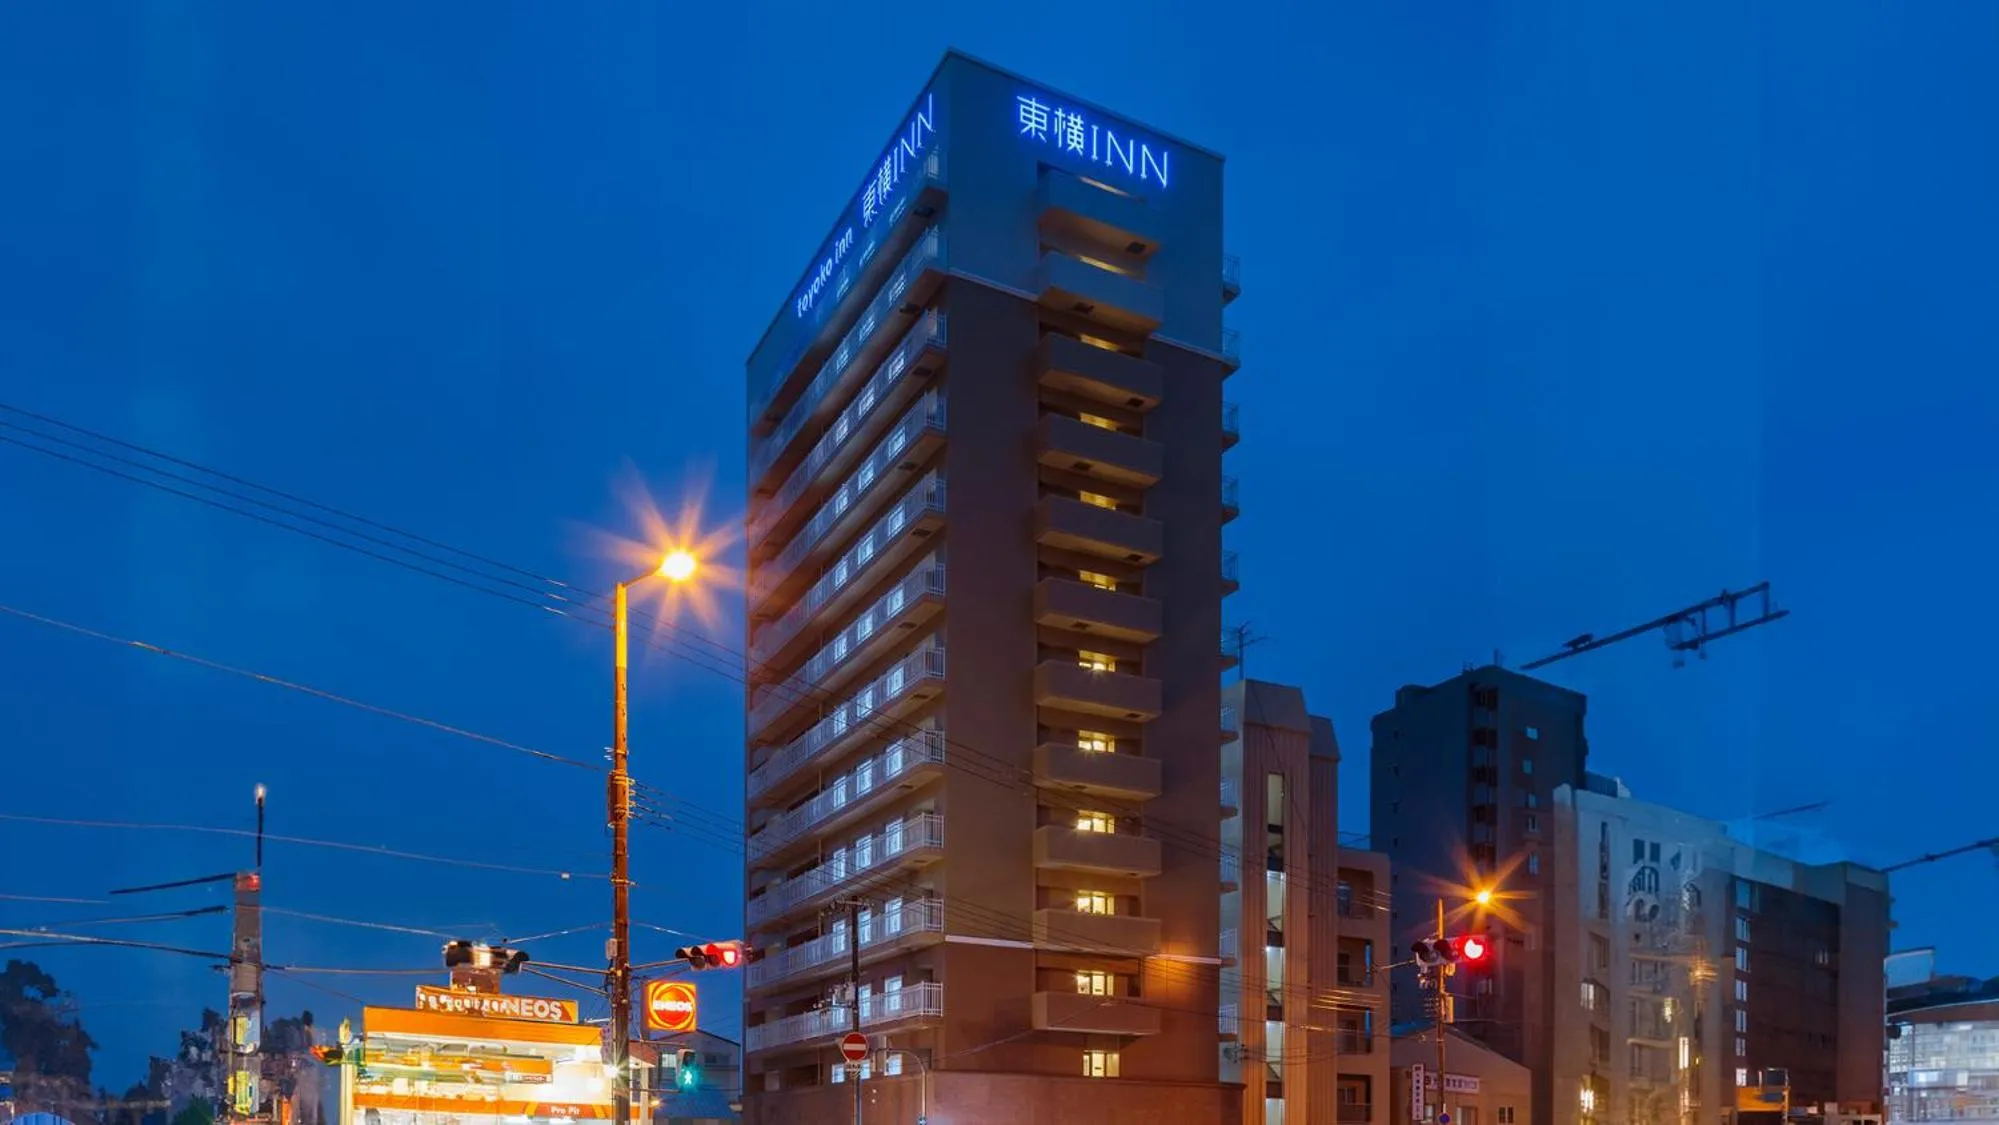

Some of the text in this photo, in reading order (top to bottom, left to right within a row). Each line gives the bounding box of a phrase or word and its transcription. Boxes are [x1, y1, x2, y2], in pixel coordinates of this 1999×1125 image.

[863, 92, 935, 228] 東横INN
[1017, 95, 1168, 188] 東横INN
[798, 227, 853, 318] toyoko inn
